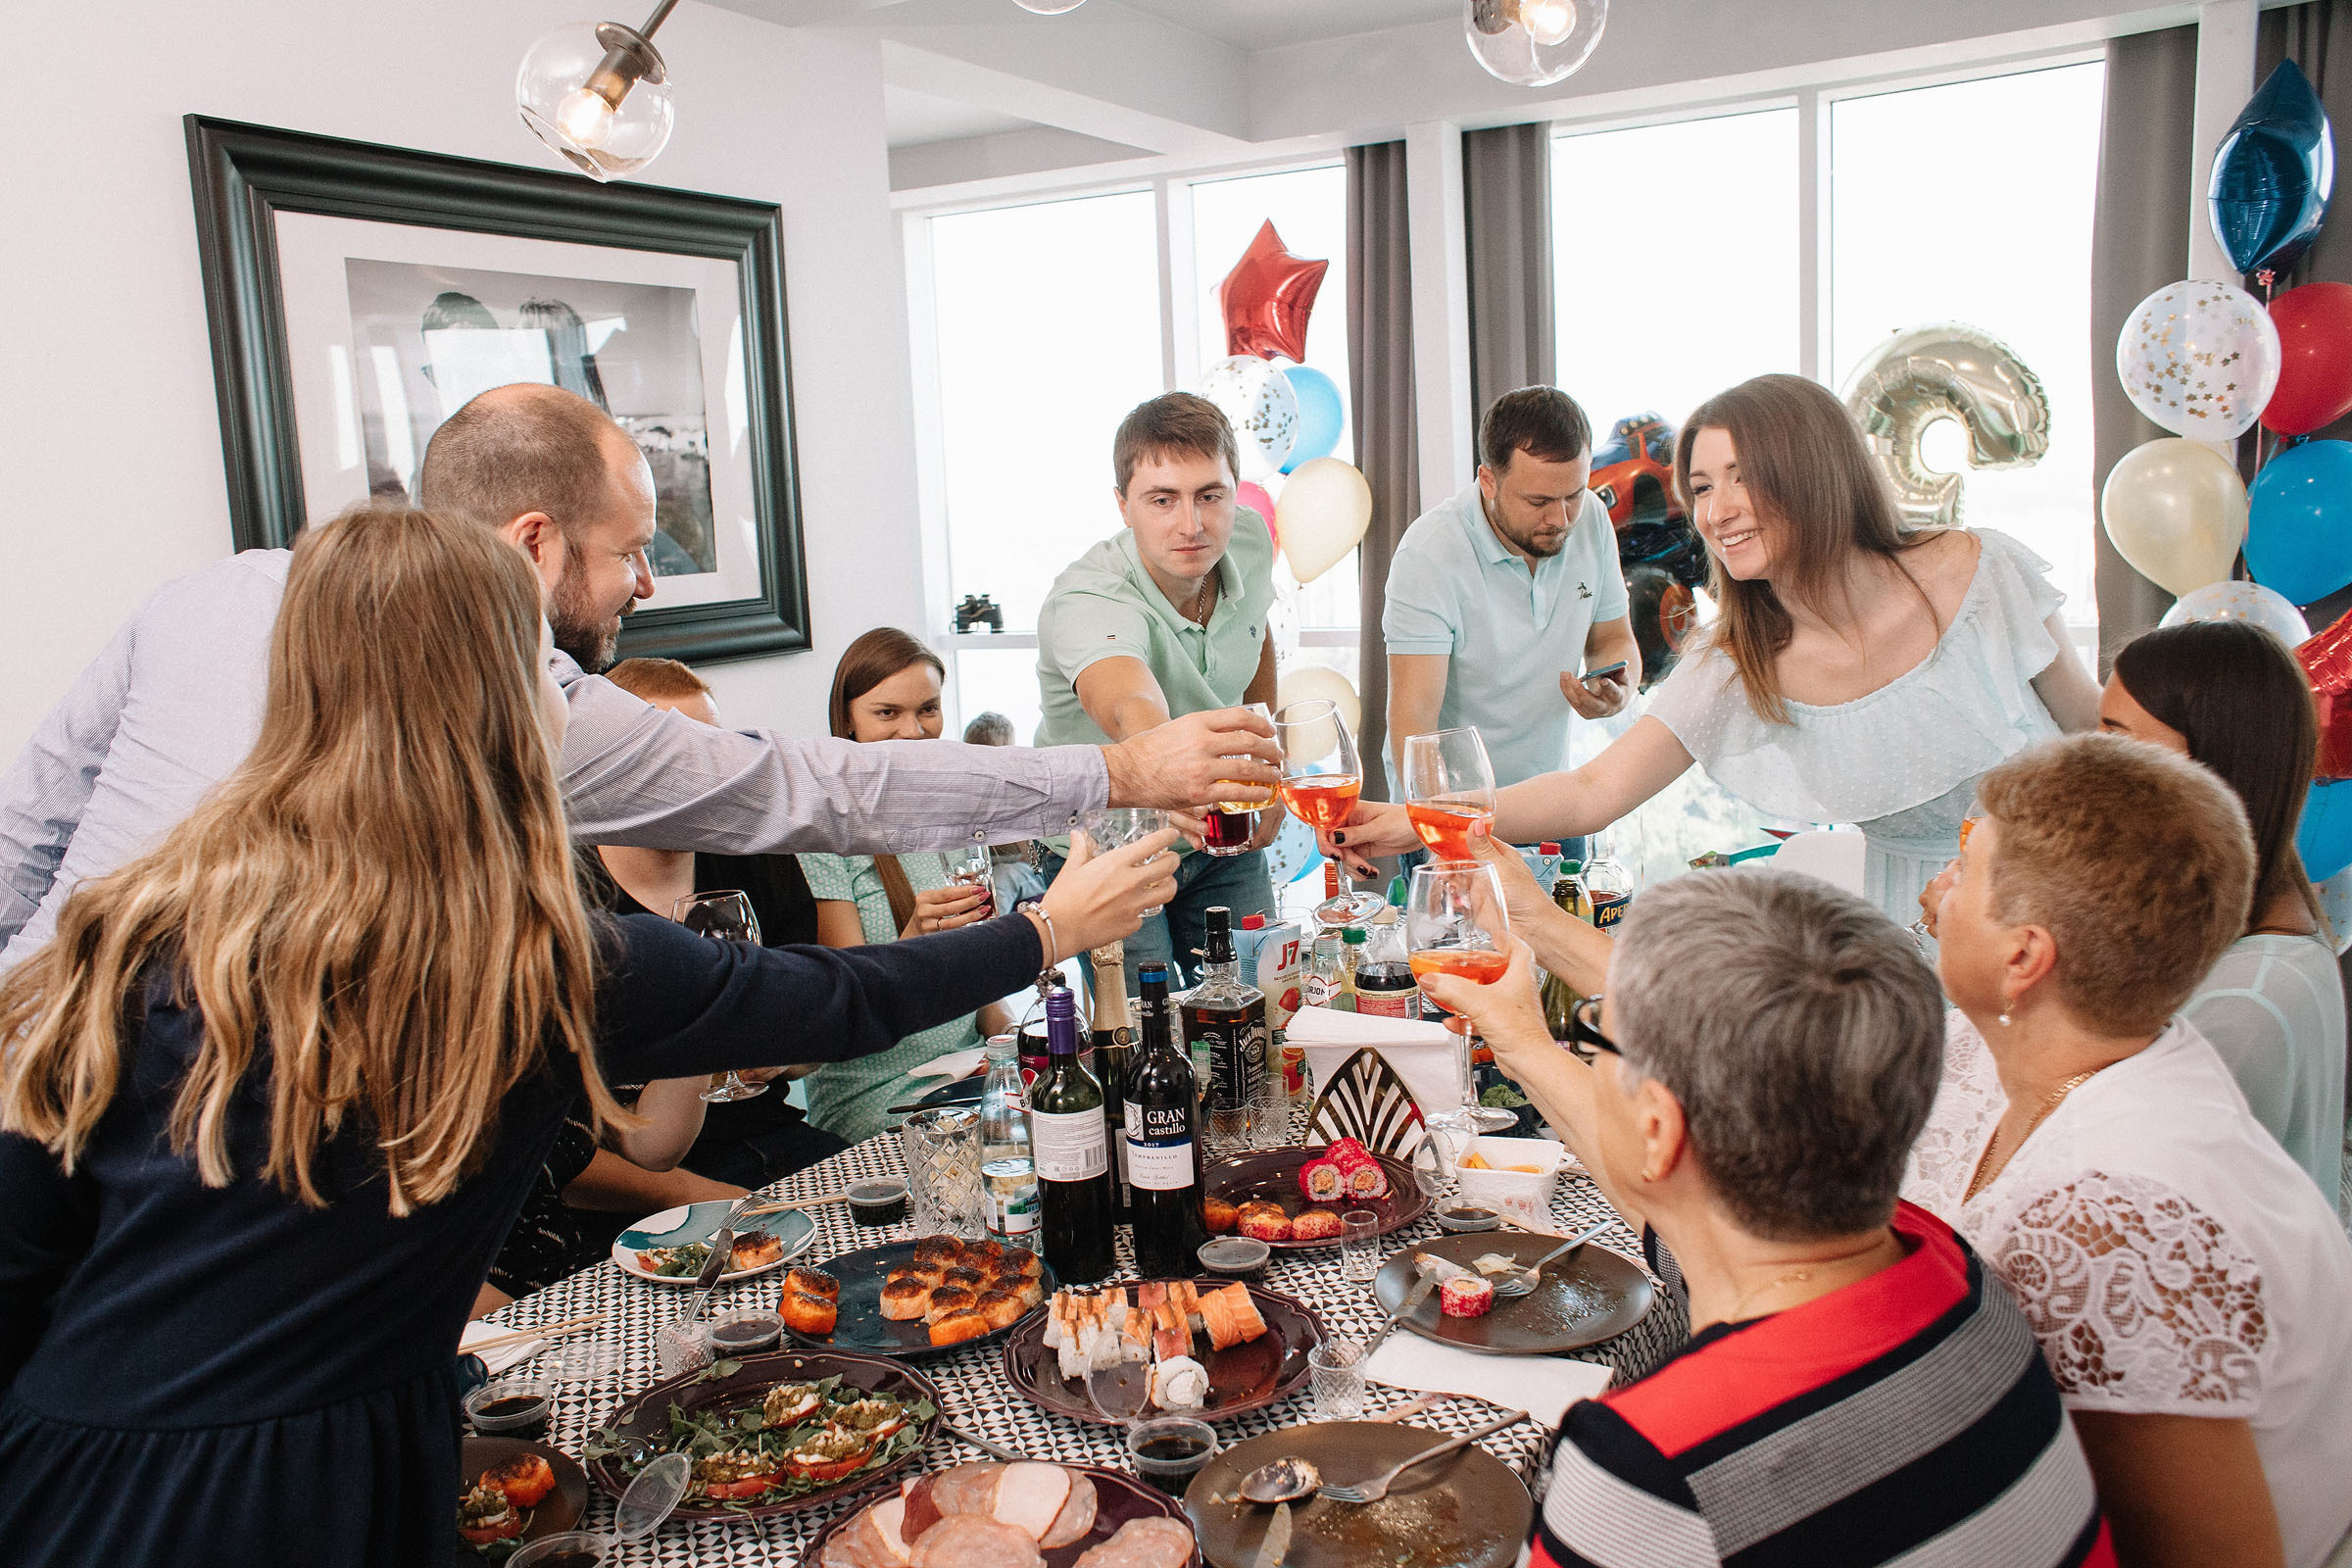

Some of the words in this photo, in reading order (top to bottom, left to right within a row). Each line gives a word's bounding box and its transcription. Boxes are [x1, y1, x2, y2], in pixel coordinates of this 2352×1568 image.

[1598, 903, 1630, 924] APE
[1277, 940, 1299, 971] J7
[1141, 1000, 1153, 1008] RAN
[1147, 1107, 1185, 1125] GRAN
[1149, 1122, 1186, 1136] castillo
